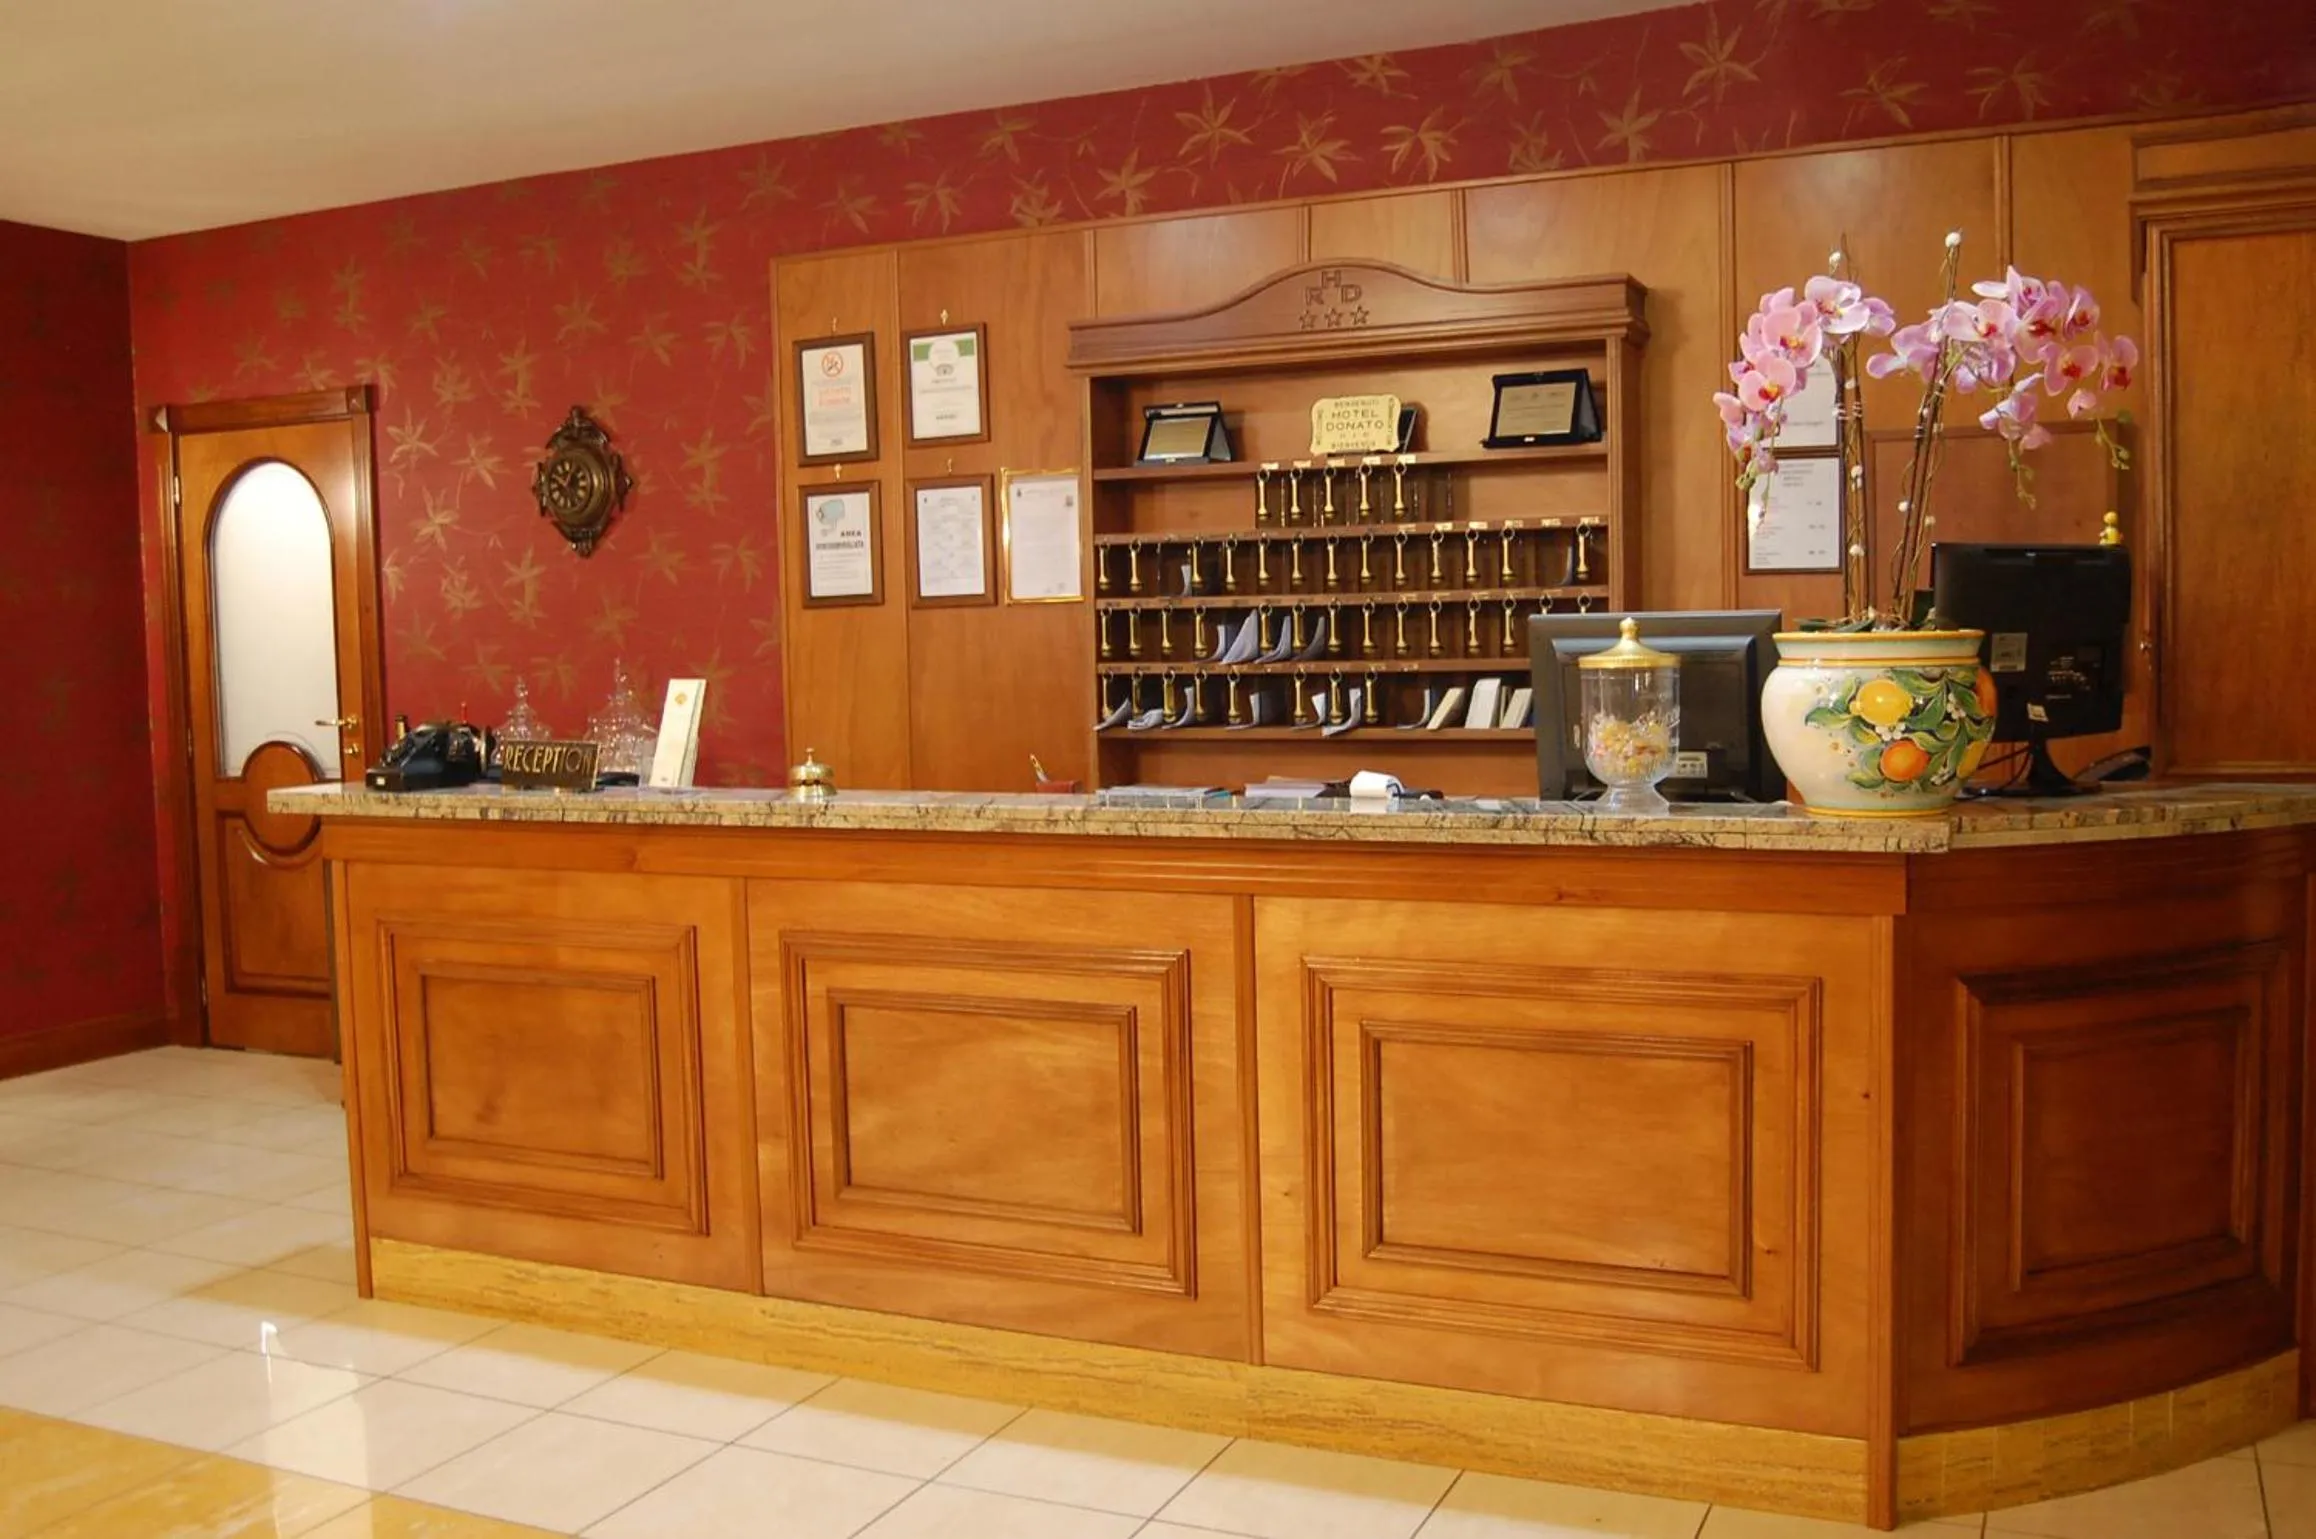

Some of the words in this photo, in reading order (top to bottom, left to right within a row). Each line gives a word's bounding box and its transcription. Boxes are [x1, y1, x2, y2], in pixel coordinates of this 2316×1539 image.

[1331, 409, 1379, 420] HOTEL
[1325, 420, 1385, 432] DONATO
[504, 744, 593, 775] RECEPTION
